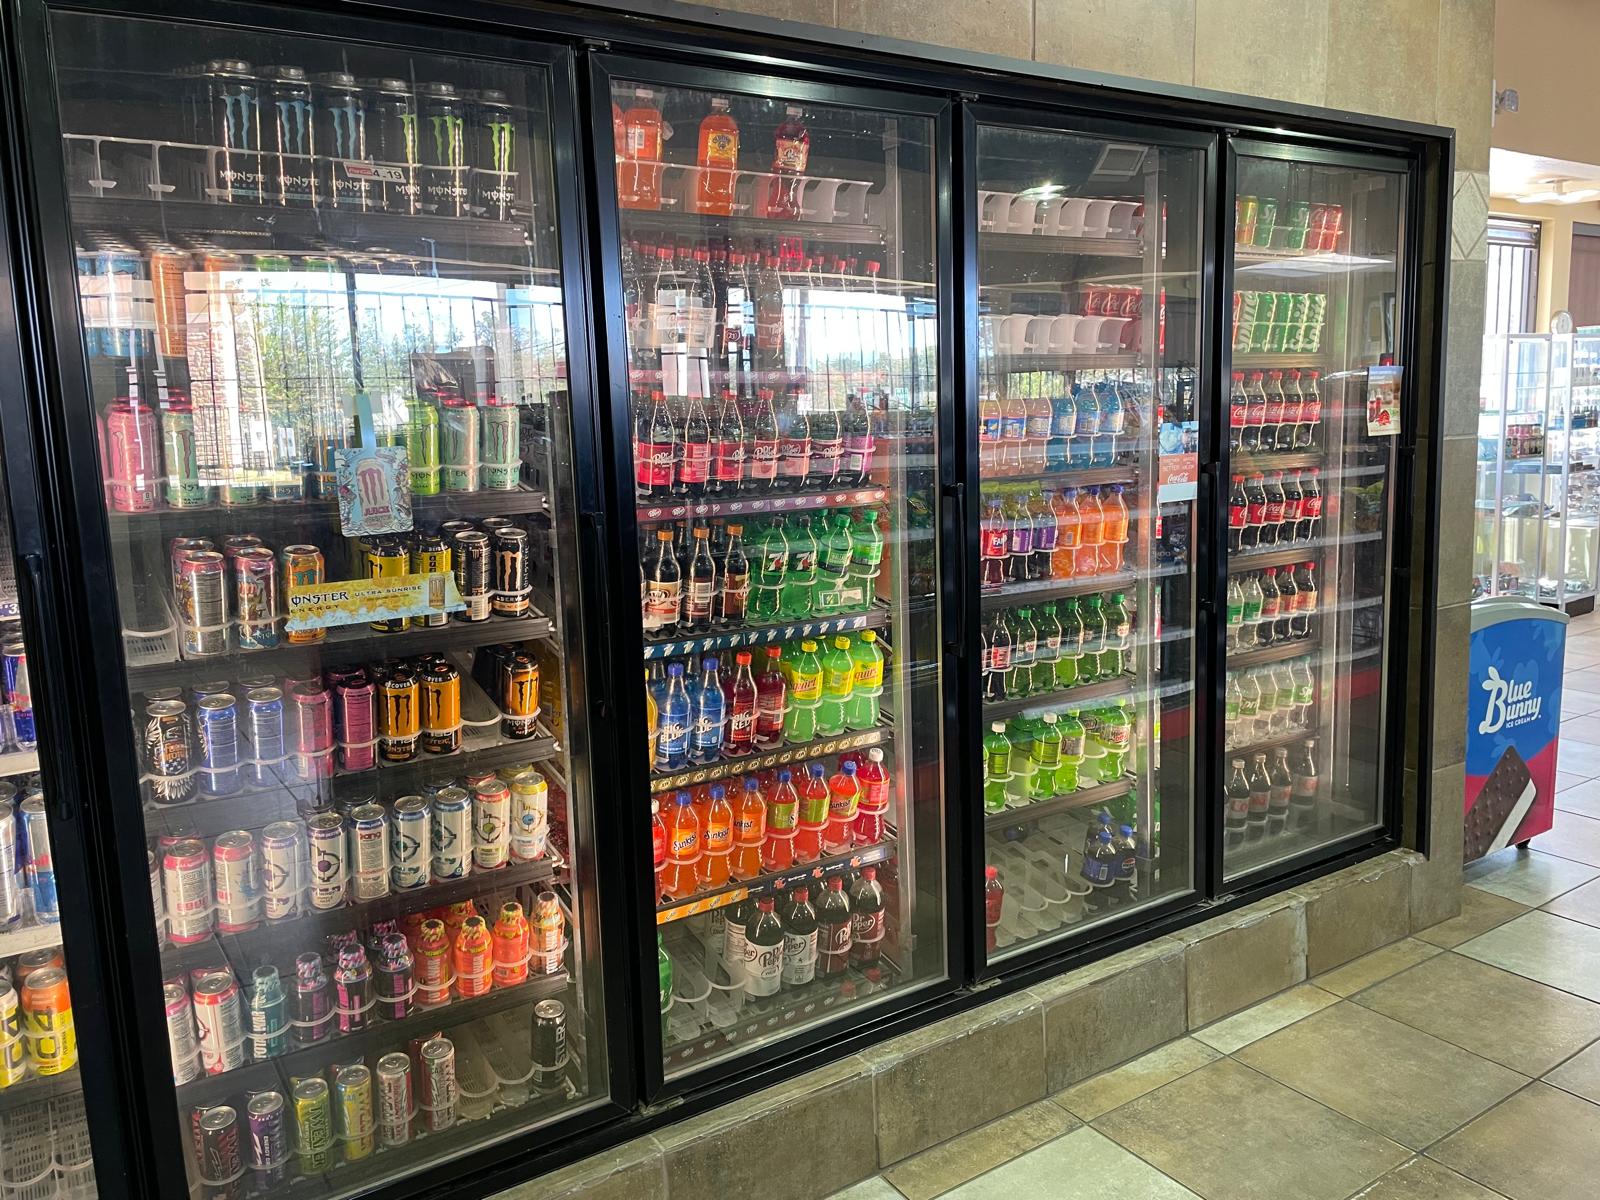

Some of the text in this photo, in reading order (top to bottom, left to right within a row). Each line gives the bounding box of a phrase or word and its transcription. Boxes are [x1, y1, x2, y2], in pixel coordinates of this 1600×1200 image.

[219, 169, 265, 183] MONSTE
[354, 589, 382, 597] ULTRA
[386, 584, 423, 594] SUNRISE
[290, 591, 349, 608] ONSTER
[1514, 716, 1531, 727] CREAM
[673, 833, 697, 851] Sunkist
[853, 919, 874, 930] pper
[33, 1009, 56, 1060] C4
[309, 1107, 326, 1168] TWEAER
